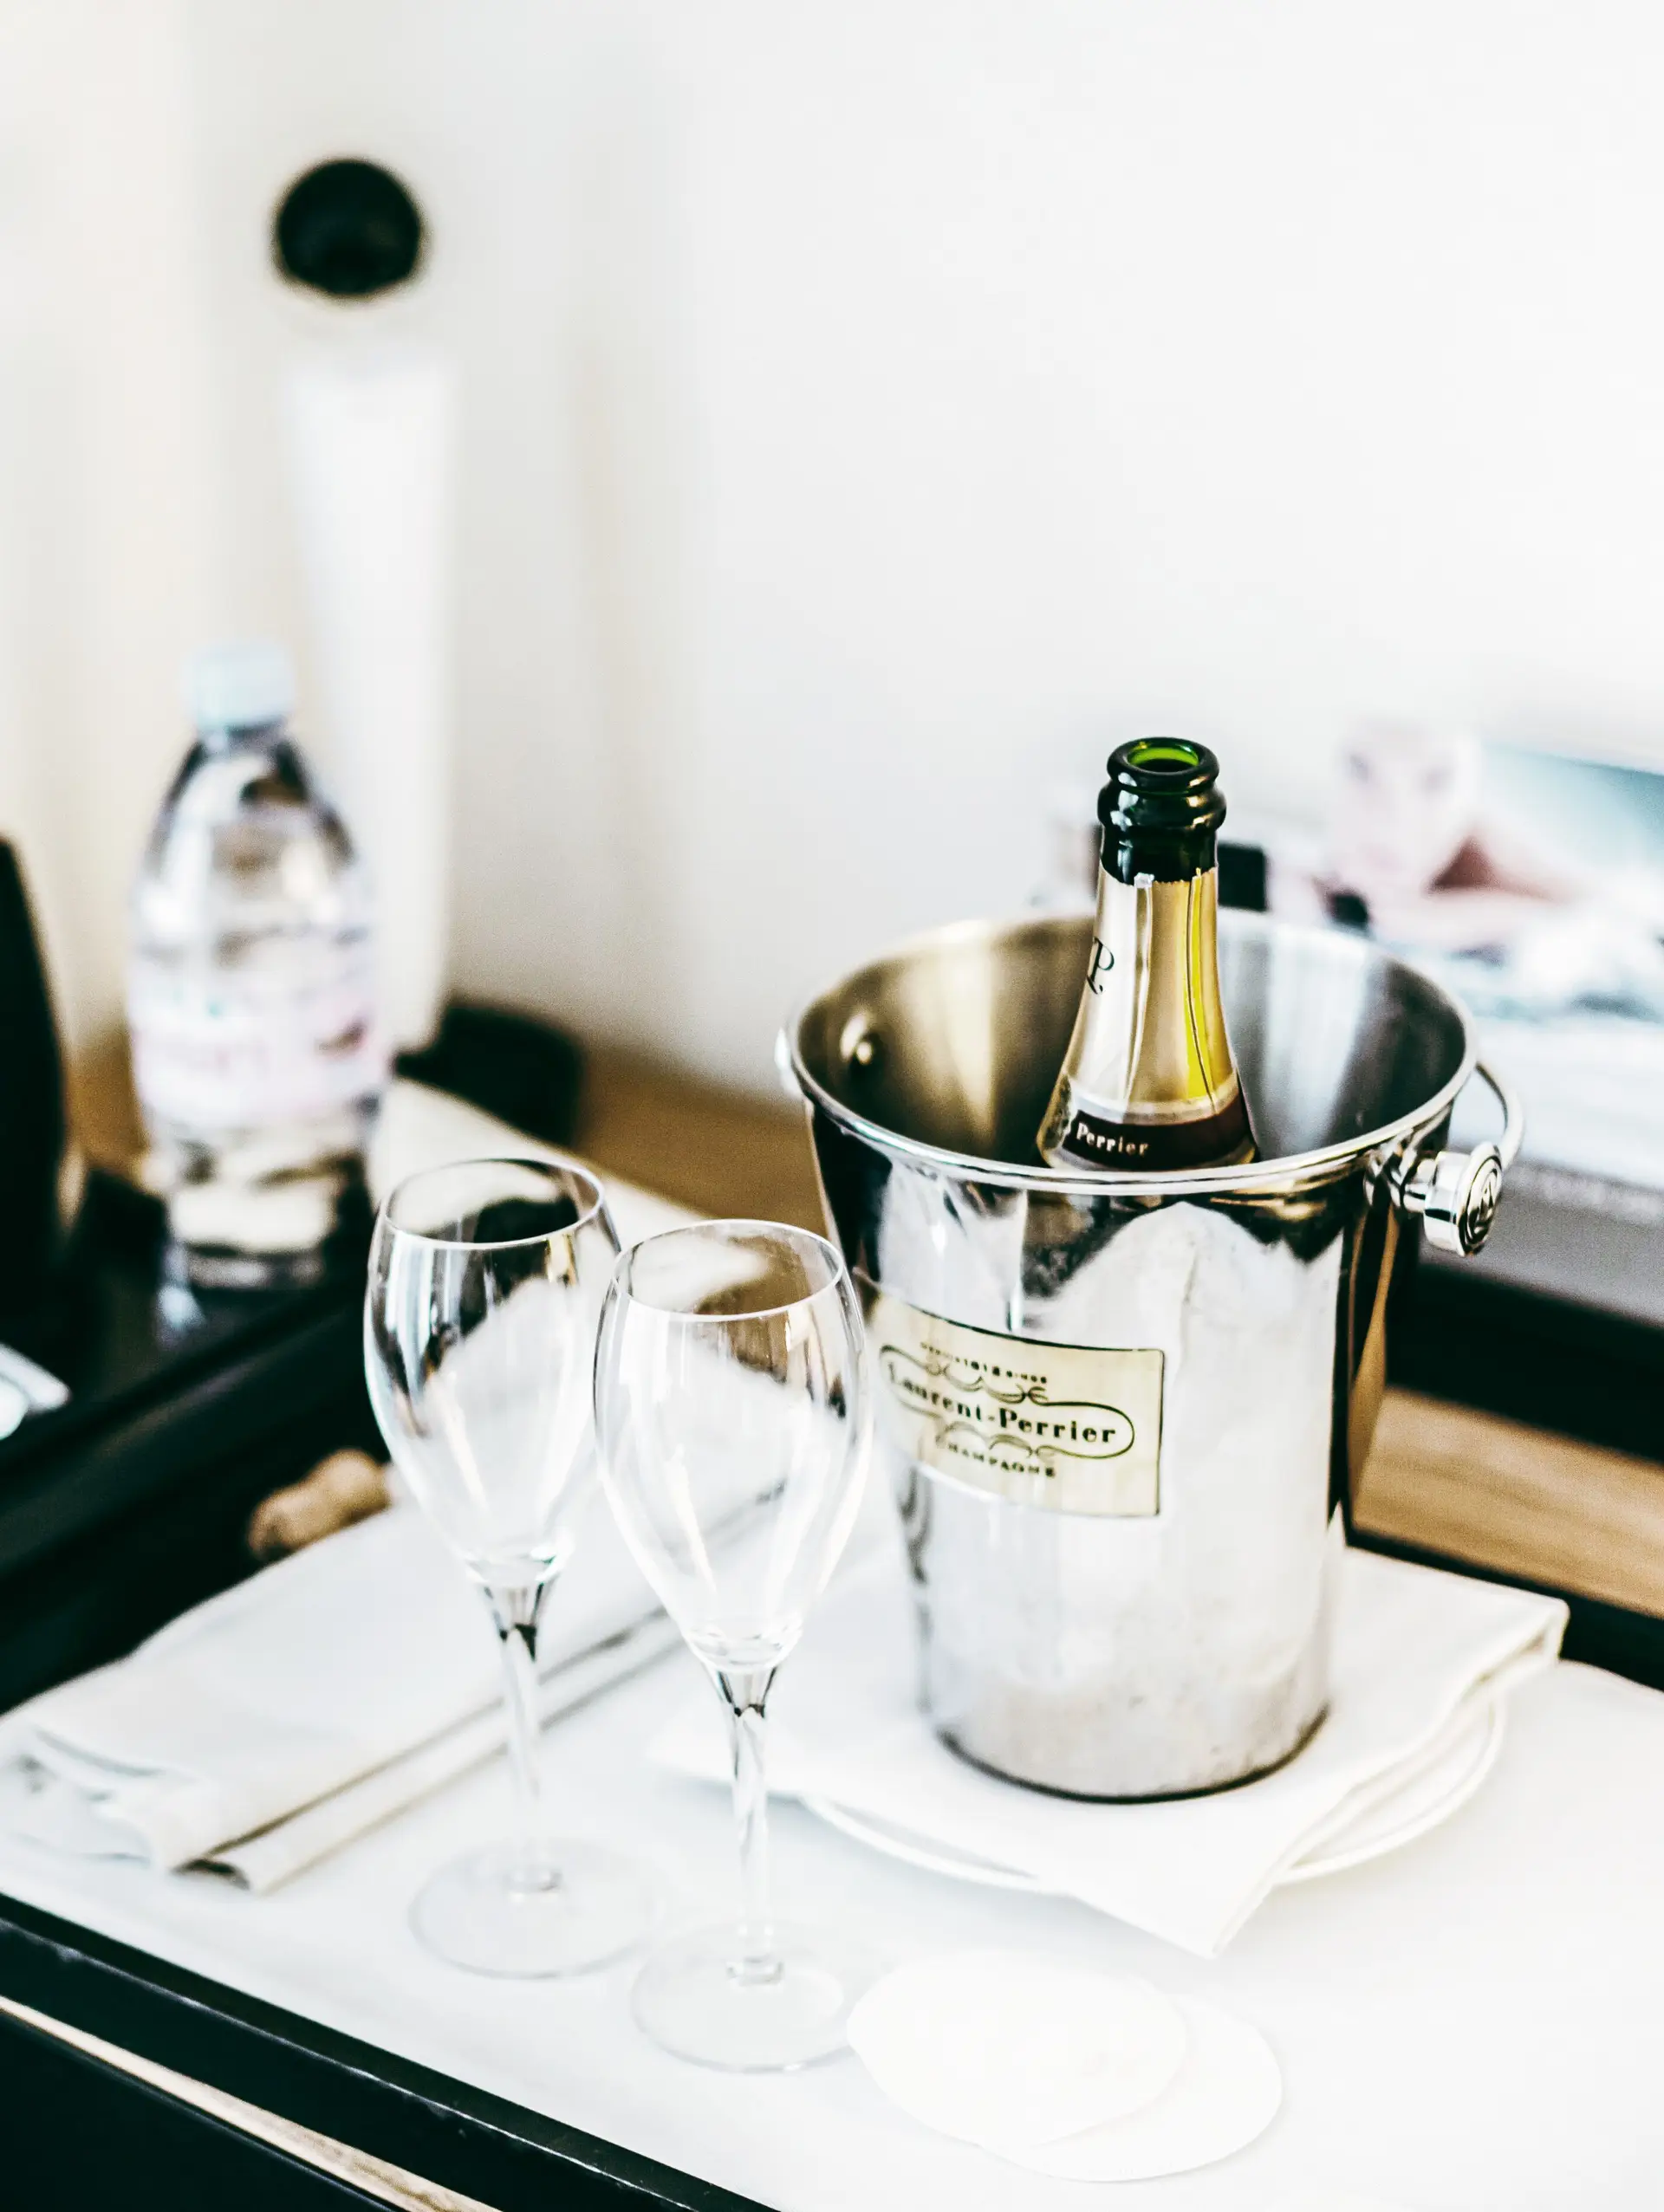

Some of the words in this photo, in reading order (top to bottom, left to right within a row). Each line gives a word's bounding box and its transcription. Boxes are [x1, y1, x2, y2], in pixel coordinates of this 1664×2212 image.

[1076, 1122, 1148, 1156] Perrier
[887, 1361, 1116, 1443] Laurent-Perrier
[943, 1439, 1055, 1477] HAMPAGNE
